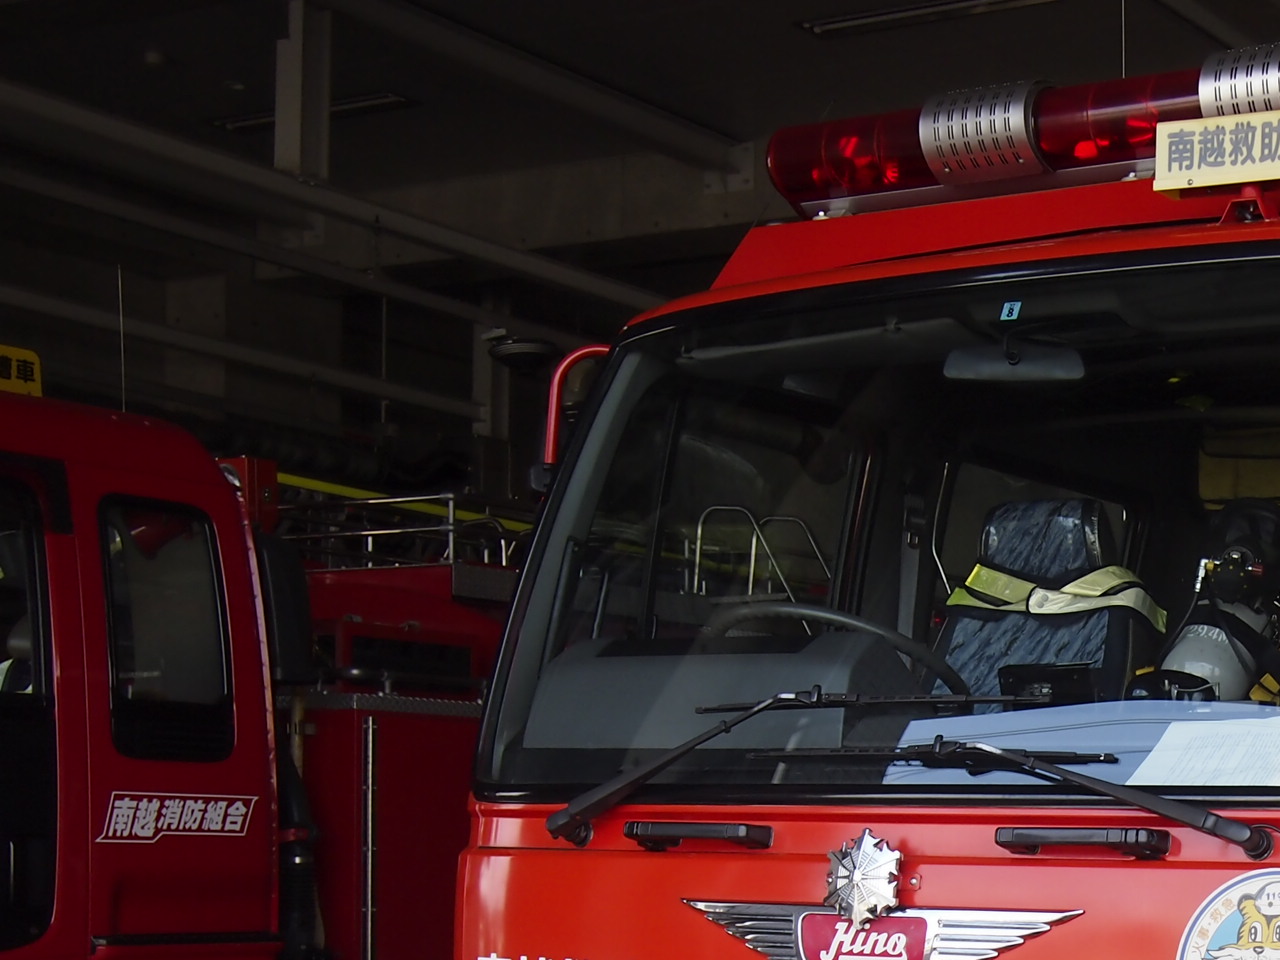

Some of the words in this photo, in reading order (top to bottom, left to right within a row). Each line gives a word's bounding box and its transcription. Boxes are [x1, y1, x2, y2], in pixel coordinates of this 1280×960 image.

[107, 797, 248, 838] 南越消防組合
